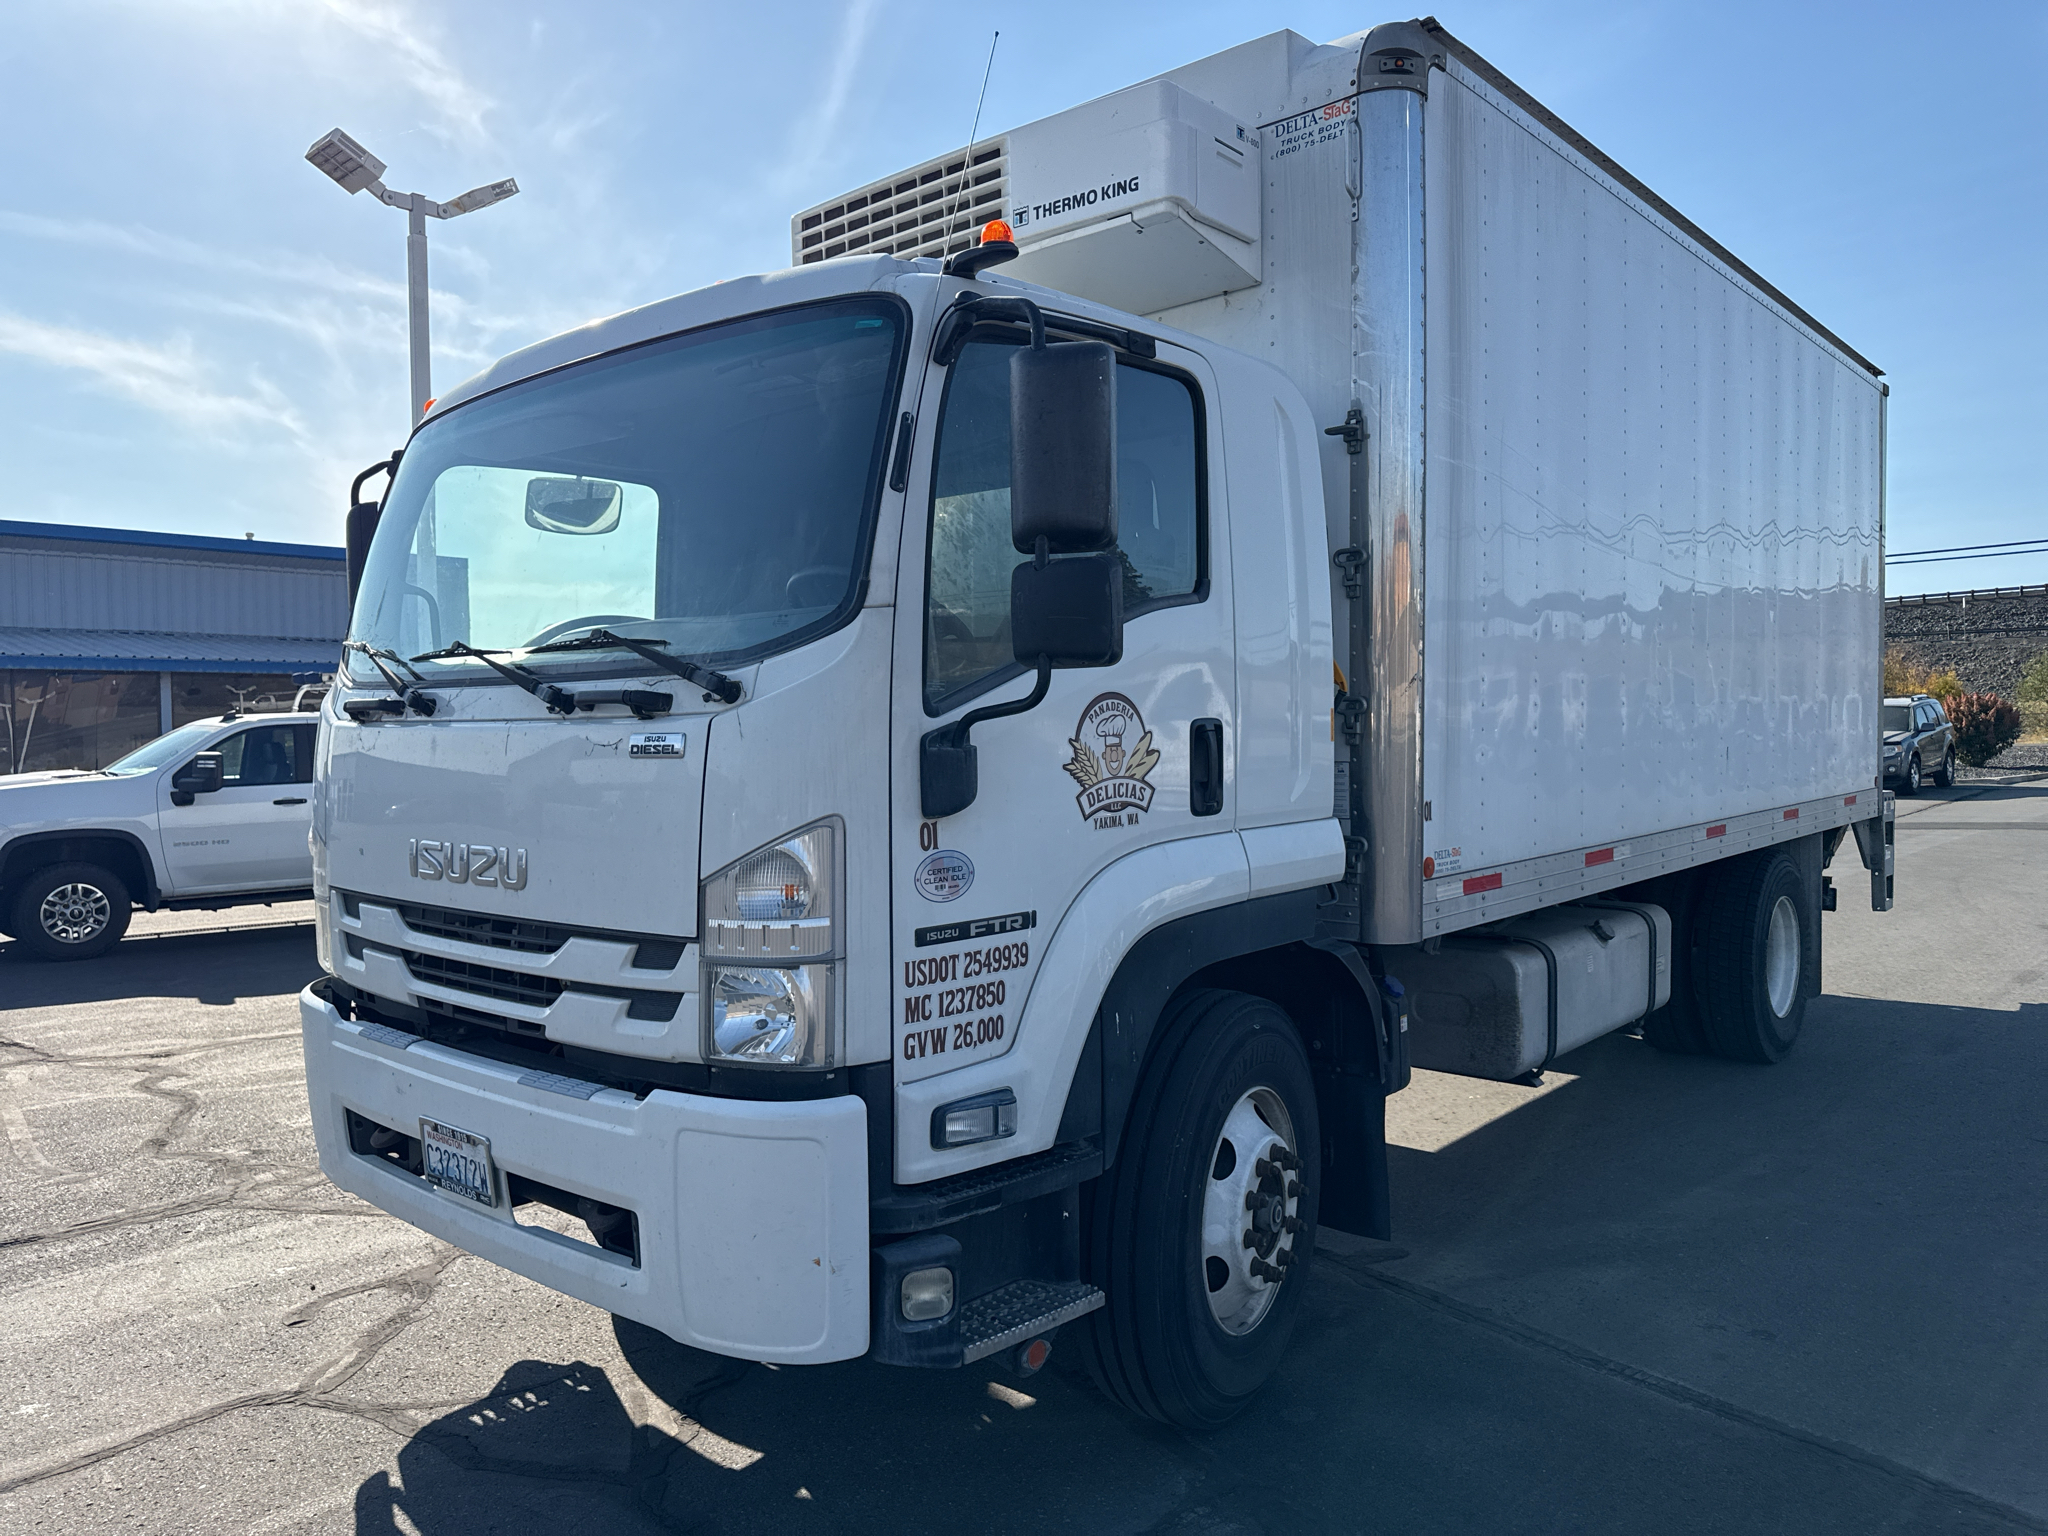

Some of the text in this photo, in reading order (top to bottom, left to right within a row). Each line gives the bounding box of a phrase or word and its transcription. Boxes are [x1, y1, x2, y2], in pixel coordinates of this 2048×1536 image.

[1245, 134, 1260, 150] V-800
[1275, 128, 1347, 159] (800) 75-DELT
[1280, 118, 1348, 148] TRUCK BODY
[1032, 175, 1140, 221] THERMO KING
[1088, 700, 1136, 725] PANADERIA
[630, 744, 680, 755] DIESEL
[643, 735, 667, 743] ISUZU
[1085, 782, 1147, 810] DELICIAS
[1110, 802, 1122, 810] LLC
[1093, 812, 1140, 831] YAKIMA, WA
[1424, 800, 1433, 821] 01
[919, 821, 939, 852] 01
[408, 837, 528, 891] ISUZU
[927, 865, 964, 876] CERTIFIED
[923, 873, 967, 885] CLEAN IDLE
[926, 914, 1024, 941] ISUZU FTR
[904, 941, 1030, 990] USDOT 2549939
[904, 980, 1007, 1026] MC 1237850
[903, 1015, 1005, 1062] GVW 26,000
[426, 1130, 463, 1151] WASHINGTON
[437, 1124, 453, 1138] SINCE
[440, 1178, 477, 1201] REYNOLDS
